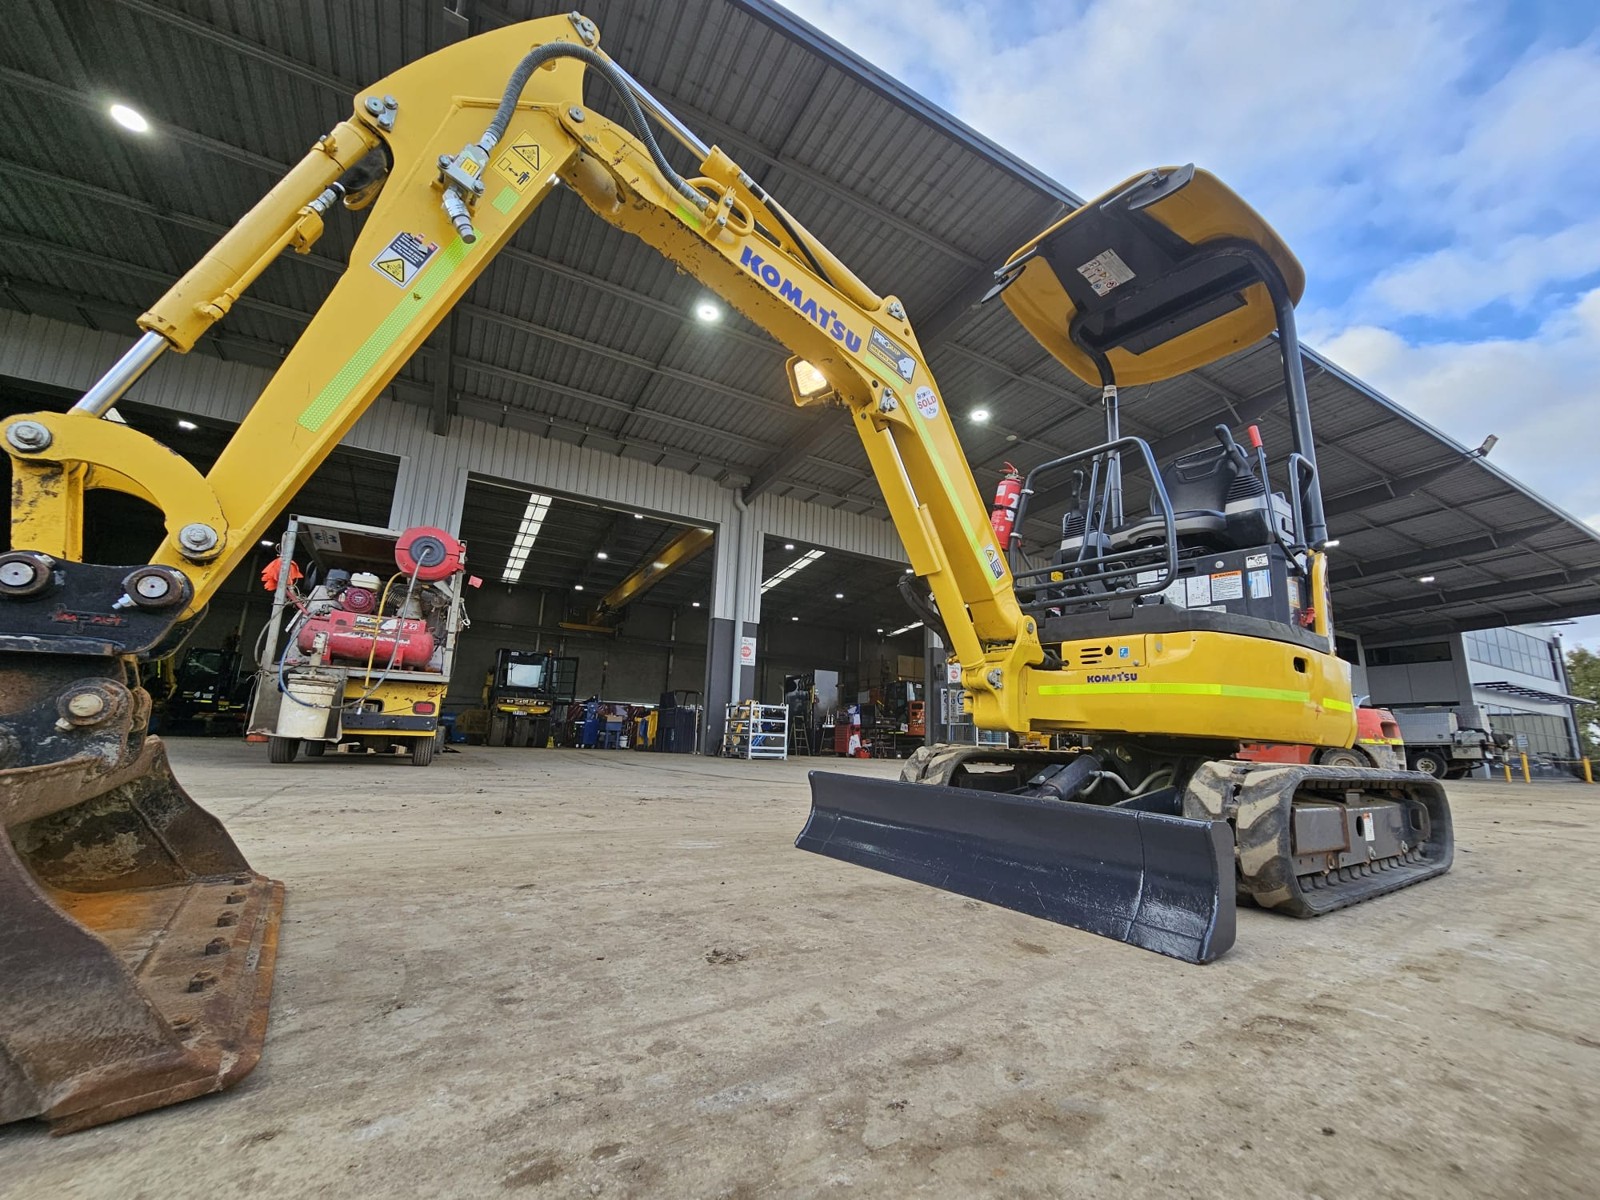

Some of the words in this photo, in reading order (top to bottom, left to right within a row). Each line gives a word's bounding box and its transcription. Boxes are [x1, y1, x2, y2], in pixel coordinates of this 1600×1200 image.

[740, 245, 862, 353] KOMATSU
[917, 395, 937, 409] SOLD
[1086, 671, 1138, 683] KOMATSU
